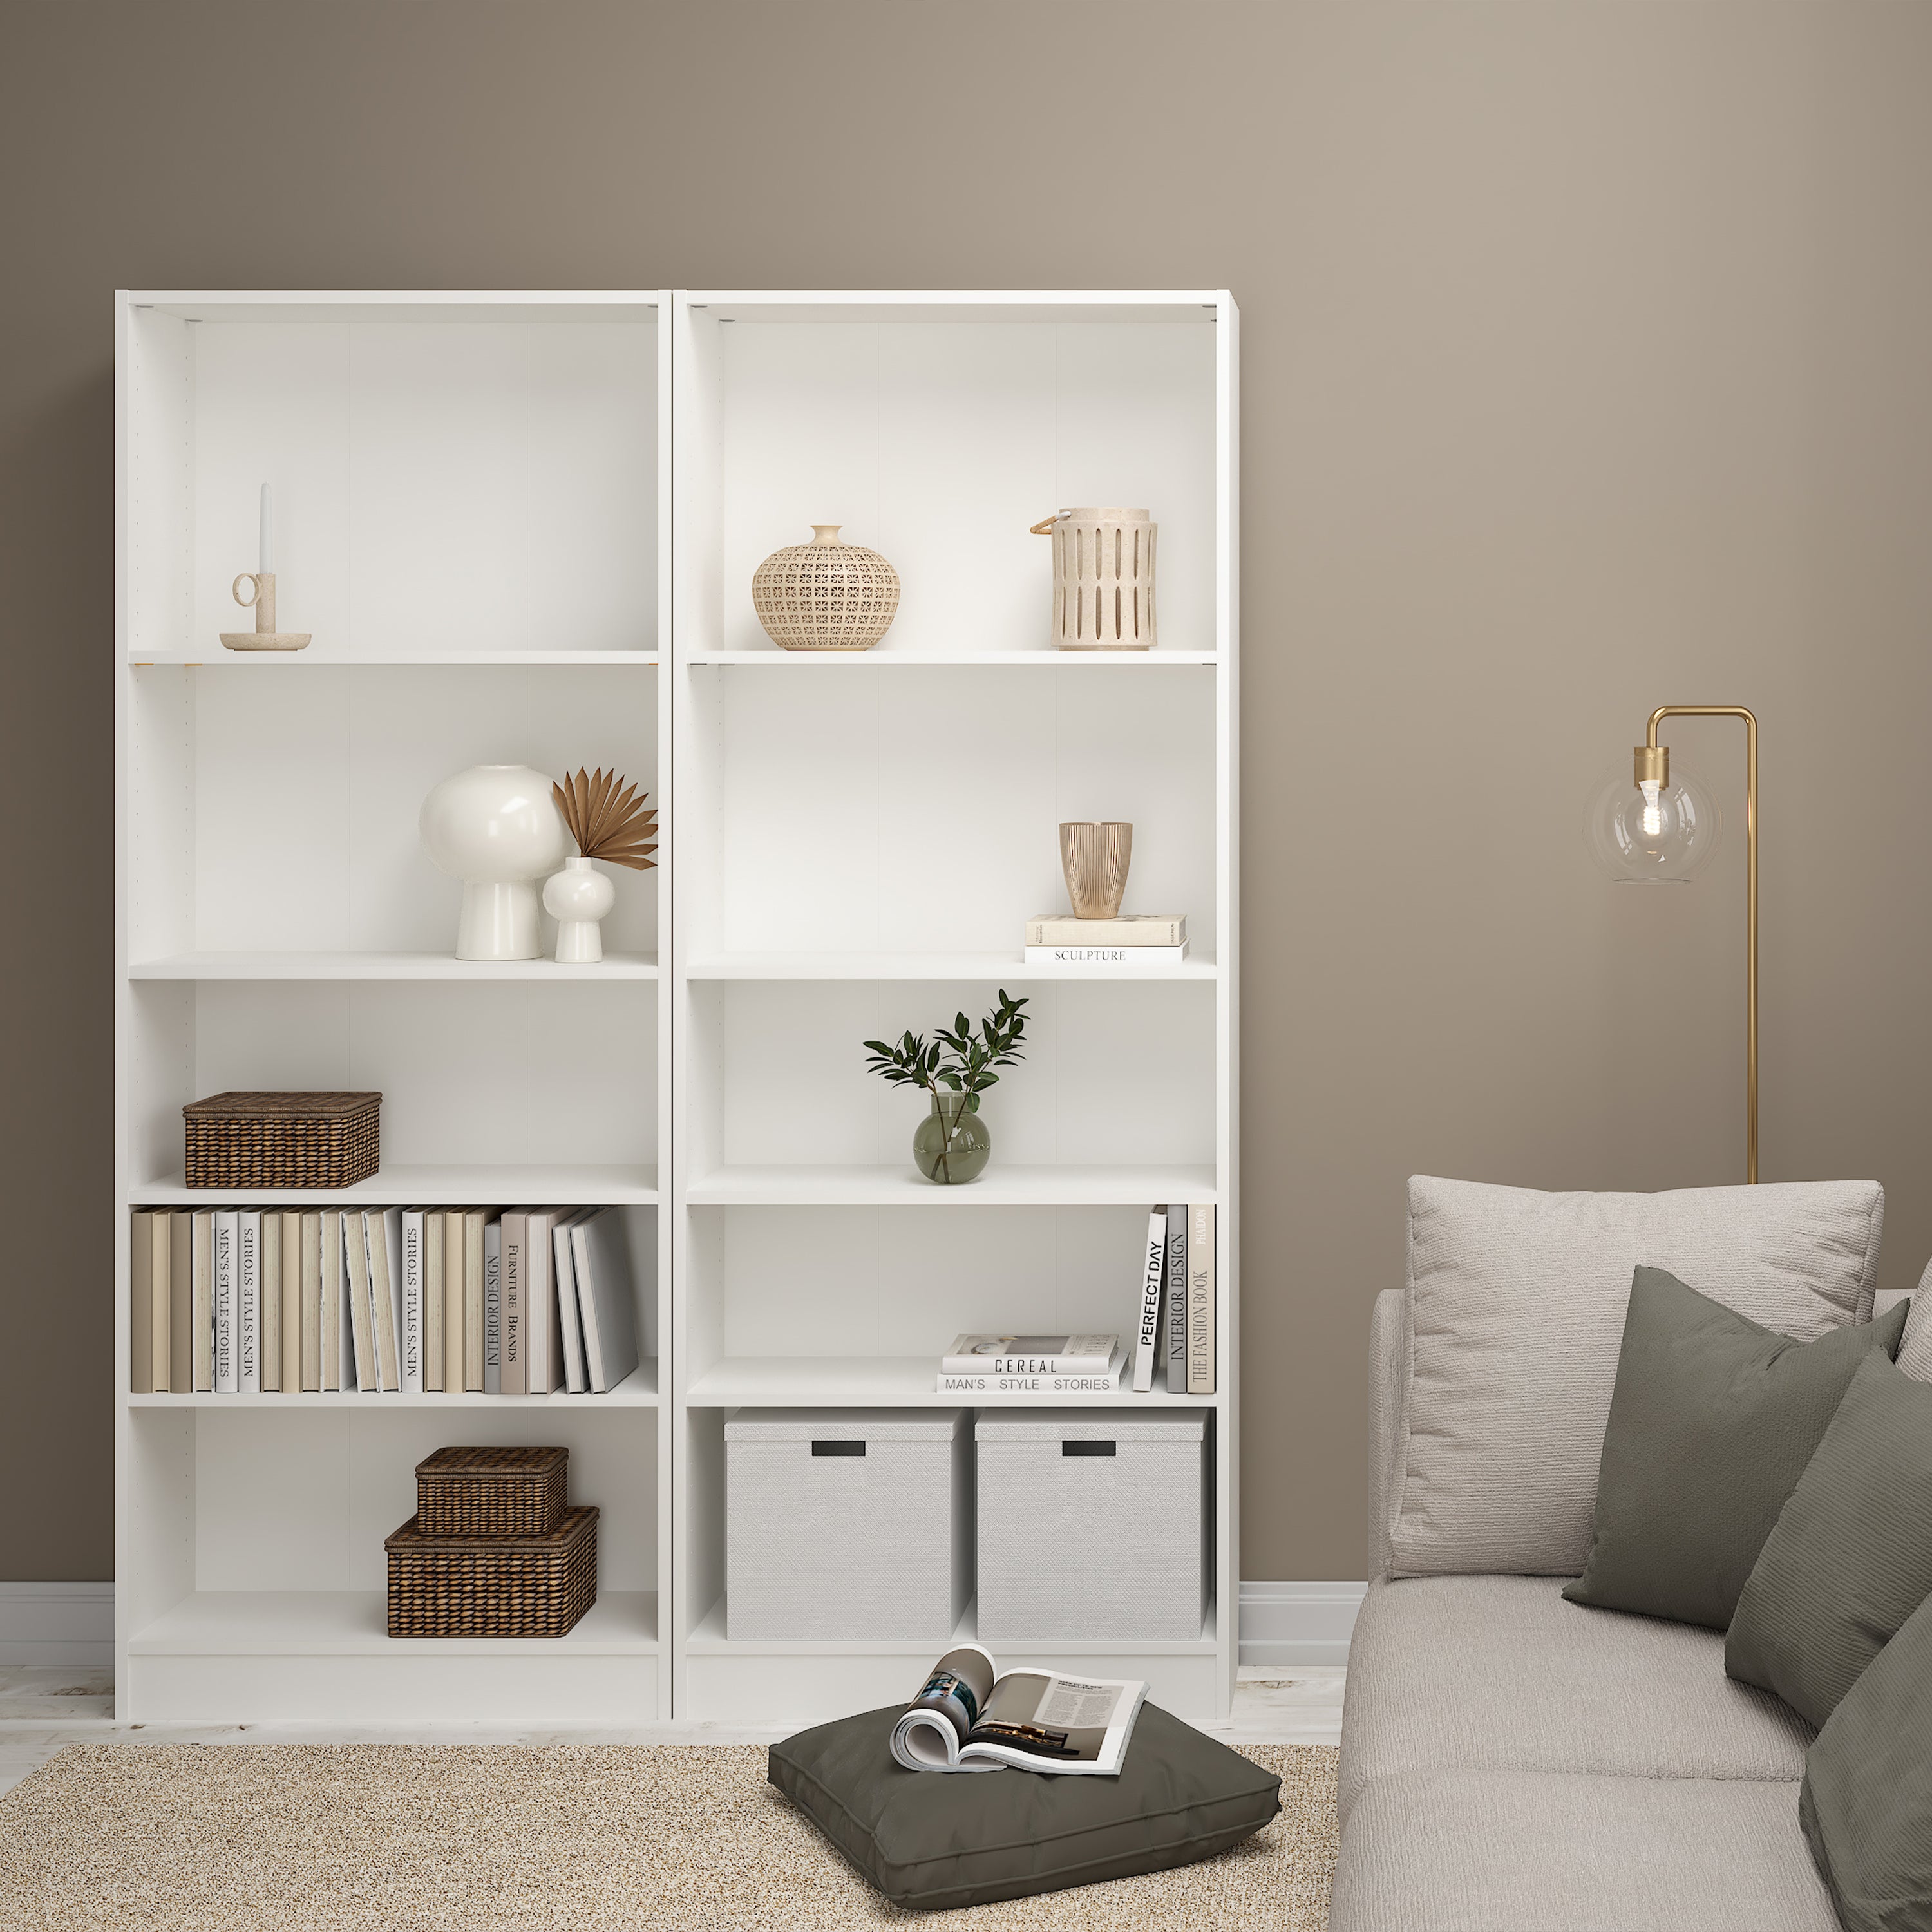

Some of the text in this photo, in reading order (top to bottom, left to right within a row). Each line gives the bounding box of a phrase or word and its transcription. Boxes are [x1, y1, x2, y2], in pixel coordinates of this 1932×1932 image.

[1055, 951, 1126, 960] SCULPTURE
[1195, 1209, 1206, 1245] PHAIDON
[220, 1229, 229, 1378] MEN'S STYLE STORIES
[244, 1228, 253, 1377] MEN'S STYLE STORIES
[408, 1228, 417, 1377] MEN'S STYLE STORIES
[488, 1256, 499, 1365] INTERIOR DESIGN
[508, 1245, 518, 1362] FURNITURE BRANDS
[1141, 1241, 1162, 1345] PERFECT DAY
[1171, 1234, 1184, 1360] INTERIOR DESIGN
[1193, 1271, 1208, 1382] THE FASHION BOOK
[945, 1379, 1110, 1390] MAN'S STYLE STORIES
[995, 1359, 1057, 1372] CEREAL
